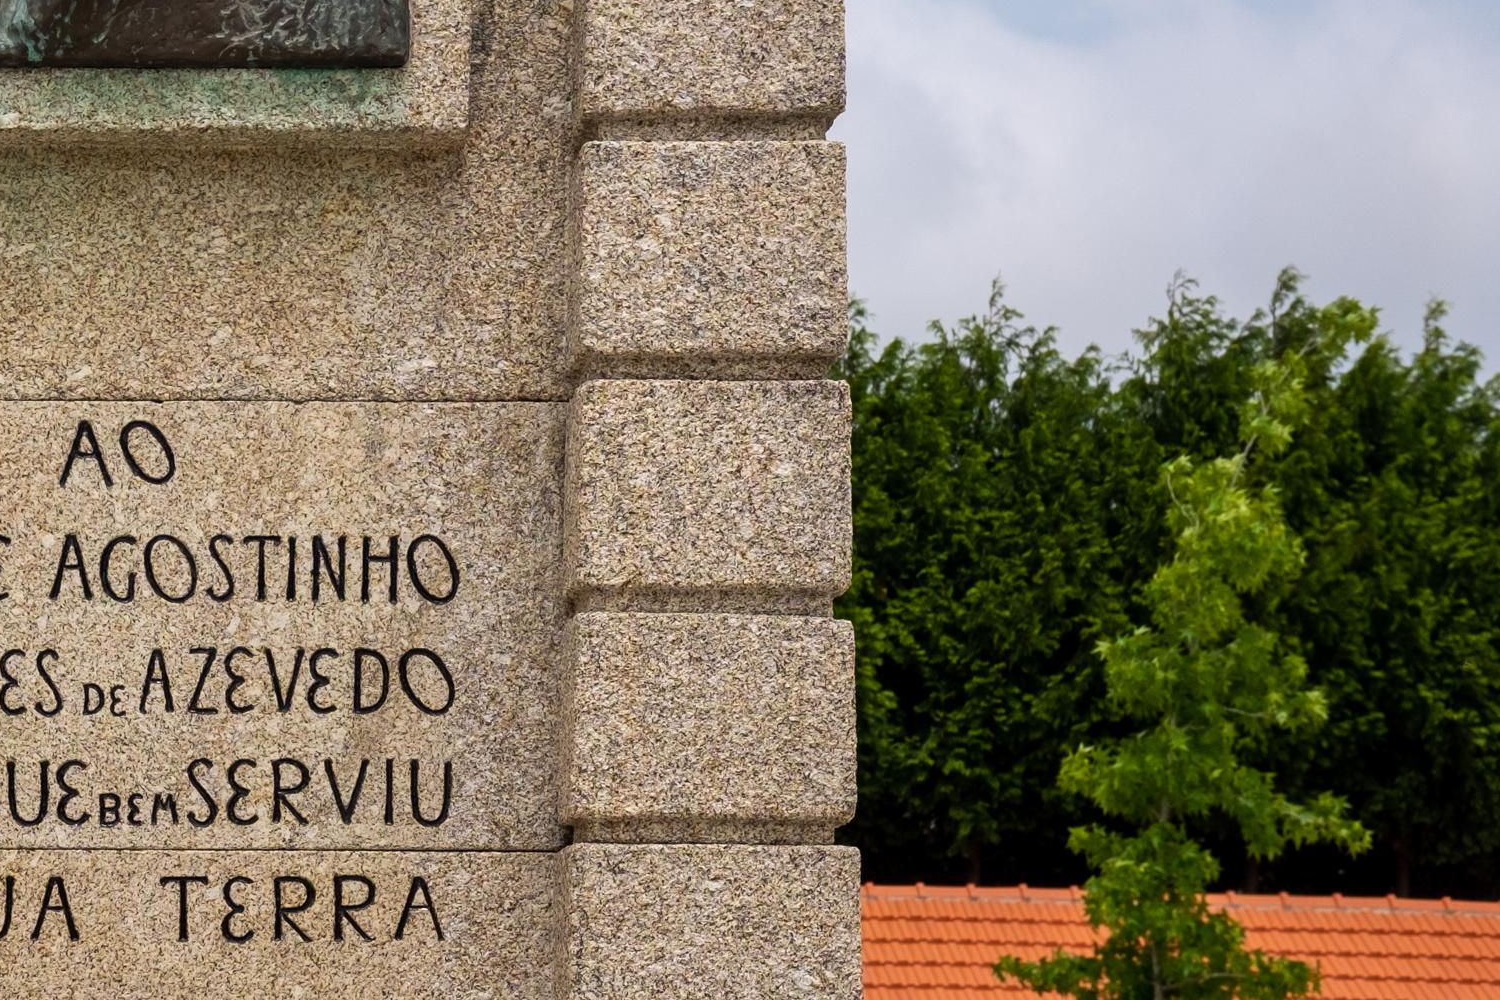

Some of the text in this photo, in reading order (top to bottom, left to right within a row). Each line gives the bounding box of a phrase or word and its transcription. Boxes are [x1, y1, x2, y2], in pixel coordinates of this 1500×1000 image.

[59, 420, 177, 487] AO
[49, 534, 461, 605] AGOSTINHO
[83, 683, 127, 717] DE
[139, 646, 456, 716] AZEVEDO
[99, 792, 180, 828] BEM
[186, 757, 454, 828] SERVIU
[159, 874, 445, 944] TERRA
